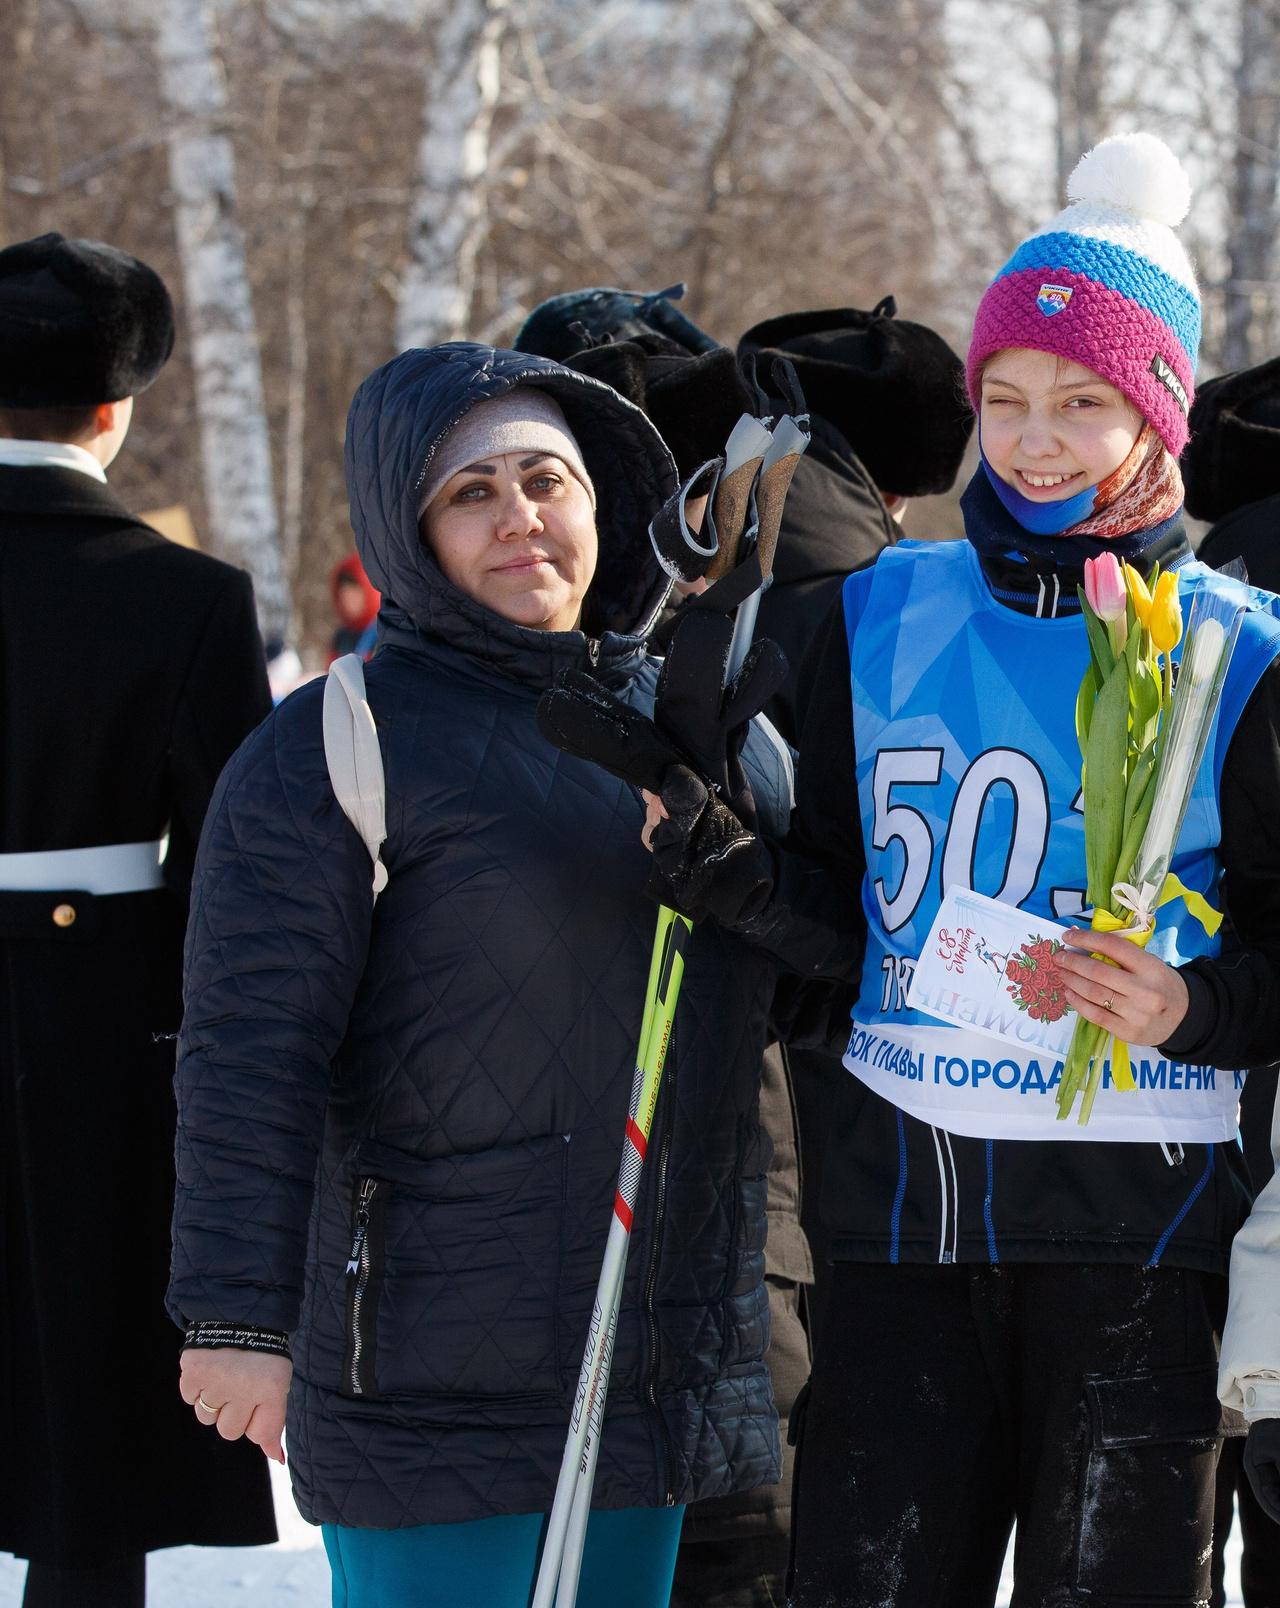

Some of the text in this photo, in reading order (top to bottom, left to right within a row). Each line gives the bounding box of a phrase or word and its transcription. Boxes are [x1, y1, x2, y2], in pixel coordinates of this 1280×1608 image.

[872, 745, 1096, 935] 50
[872, 1039, 925, 1082] ГЛАВЫ
[585, 1366, 601, 1417] CARBON
